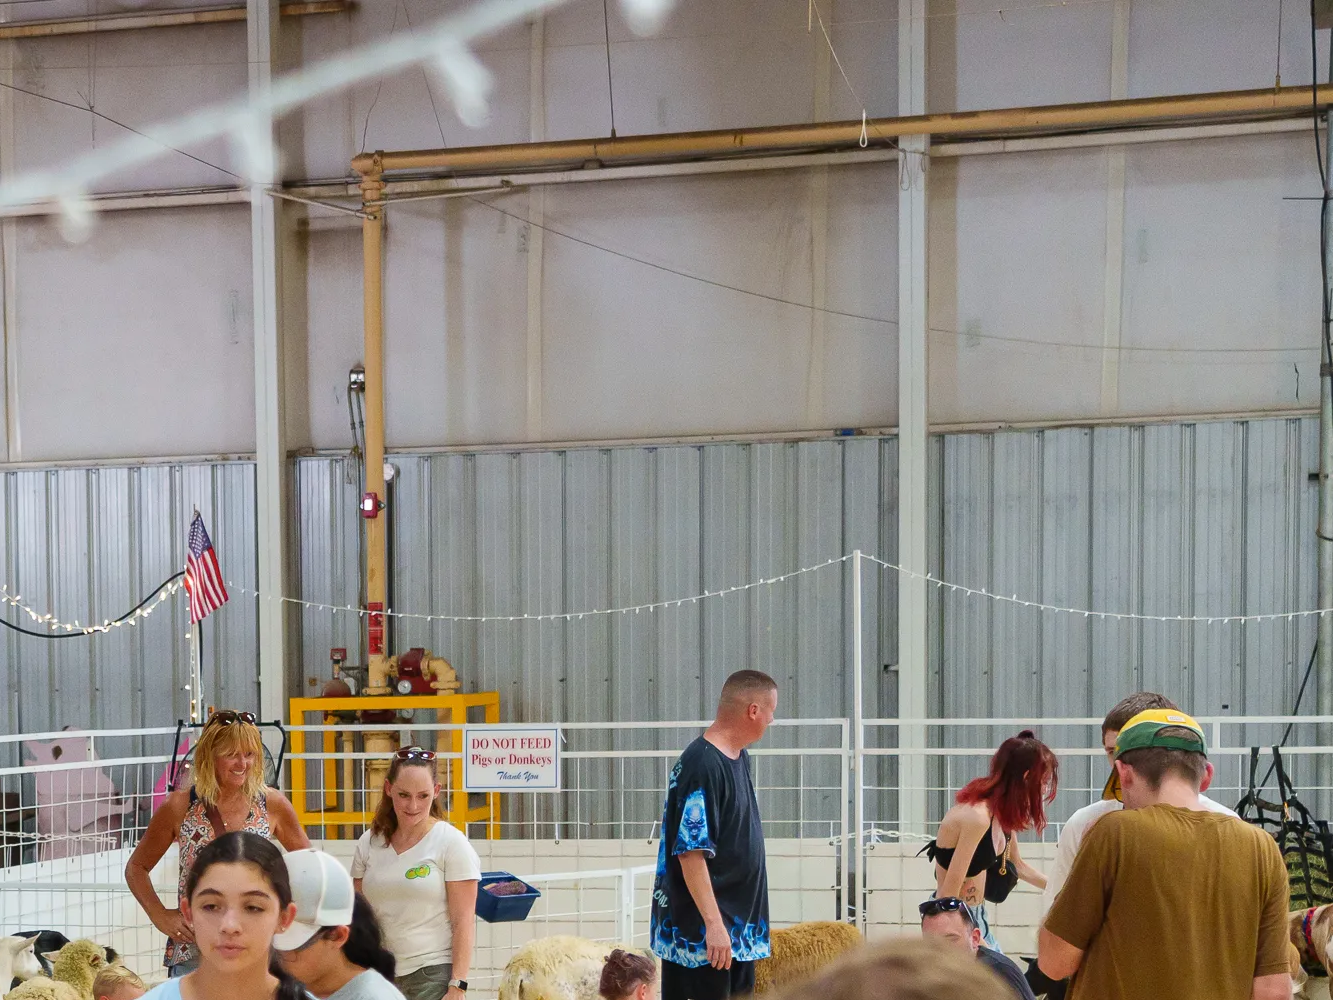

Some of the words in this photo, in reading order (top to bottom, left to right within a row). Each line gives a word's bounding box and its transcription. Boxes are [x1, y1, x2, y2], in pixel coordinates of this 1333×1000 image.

[472, 738, 489, 750] DO
[492, 738, 517, 750] NOT
[521, 737, 552, 749] FEED
[471, 754, 492, 768] Pigs
[494, 757, 506, 765] or
[509, 754, 552, 768] Donkeys
[497, 771, 522, 781] Thank
[523, 771, 539, 782] You
